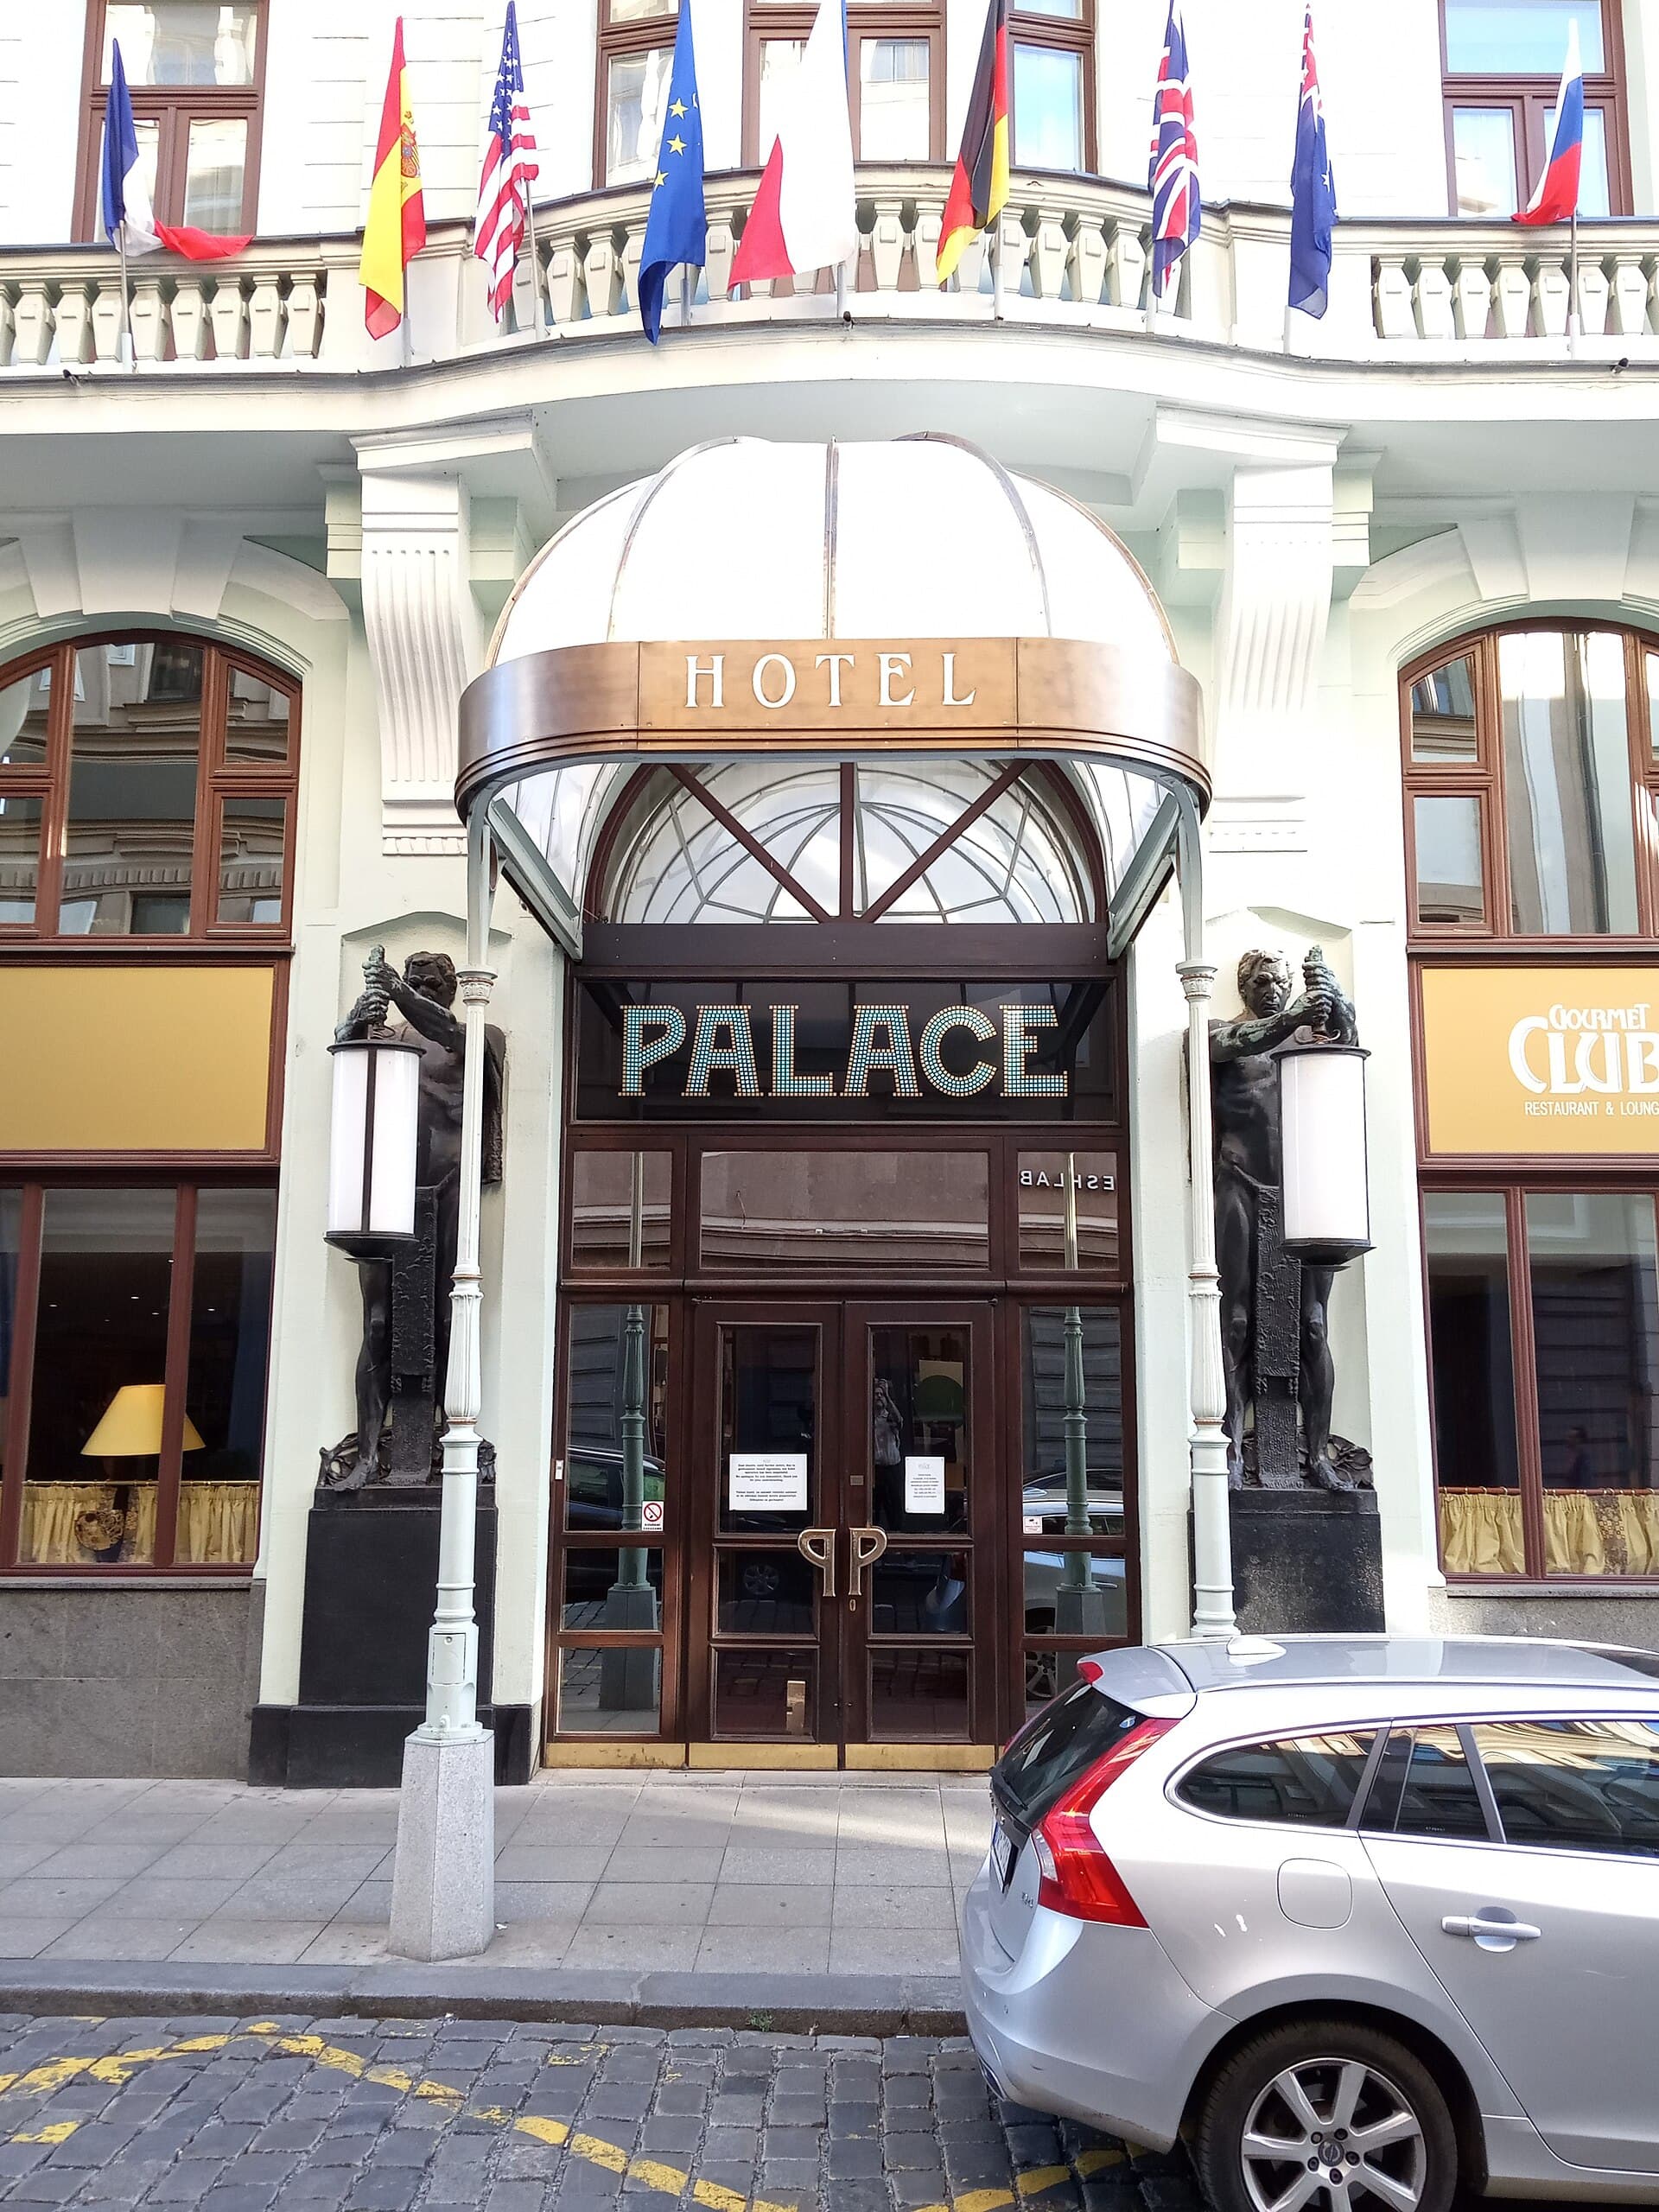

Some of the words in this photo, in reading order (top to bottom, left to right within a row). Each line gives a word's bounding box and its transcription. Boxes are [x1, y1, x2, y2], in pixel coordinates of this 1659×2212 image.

[684, 652, 976, 709] HOTEL
[1548, 1003, 1650, 1030] GOURMET
[617, 1004, 1069, 1097] PALACE
[1508, 1015, 1659, 1094] CLUB
[1524, 1101, 1599, 1116] RESTAURANT
[1605, 1101, 1614, 1116] &
